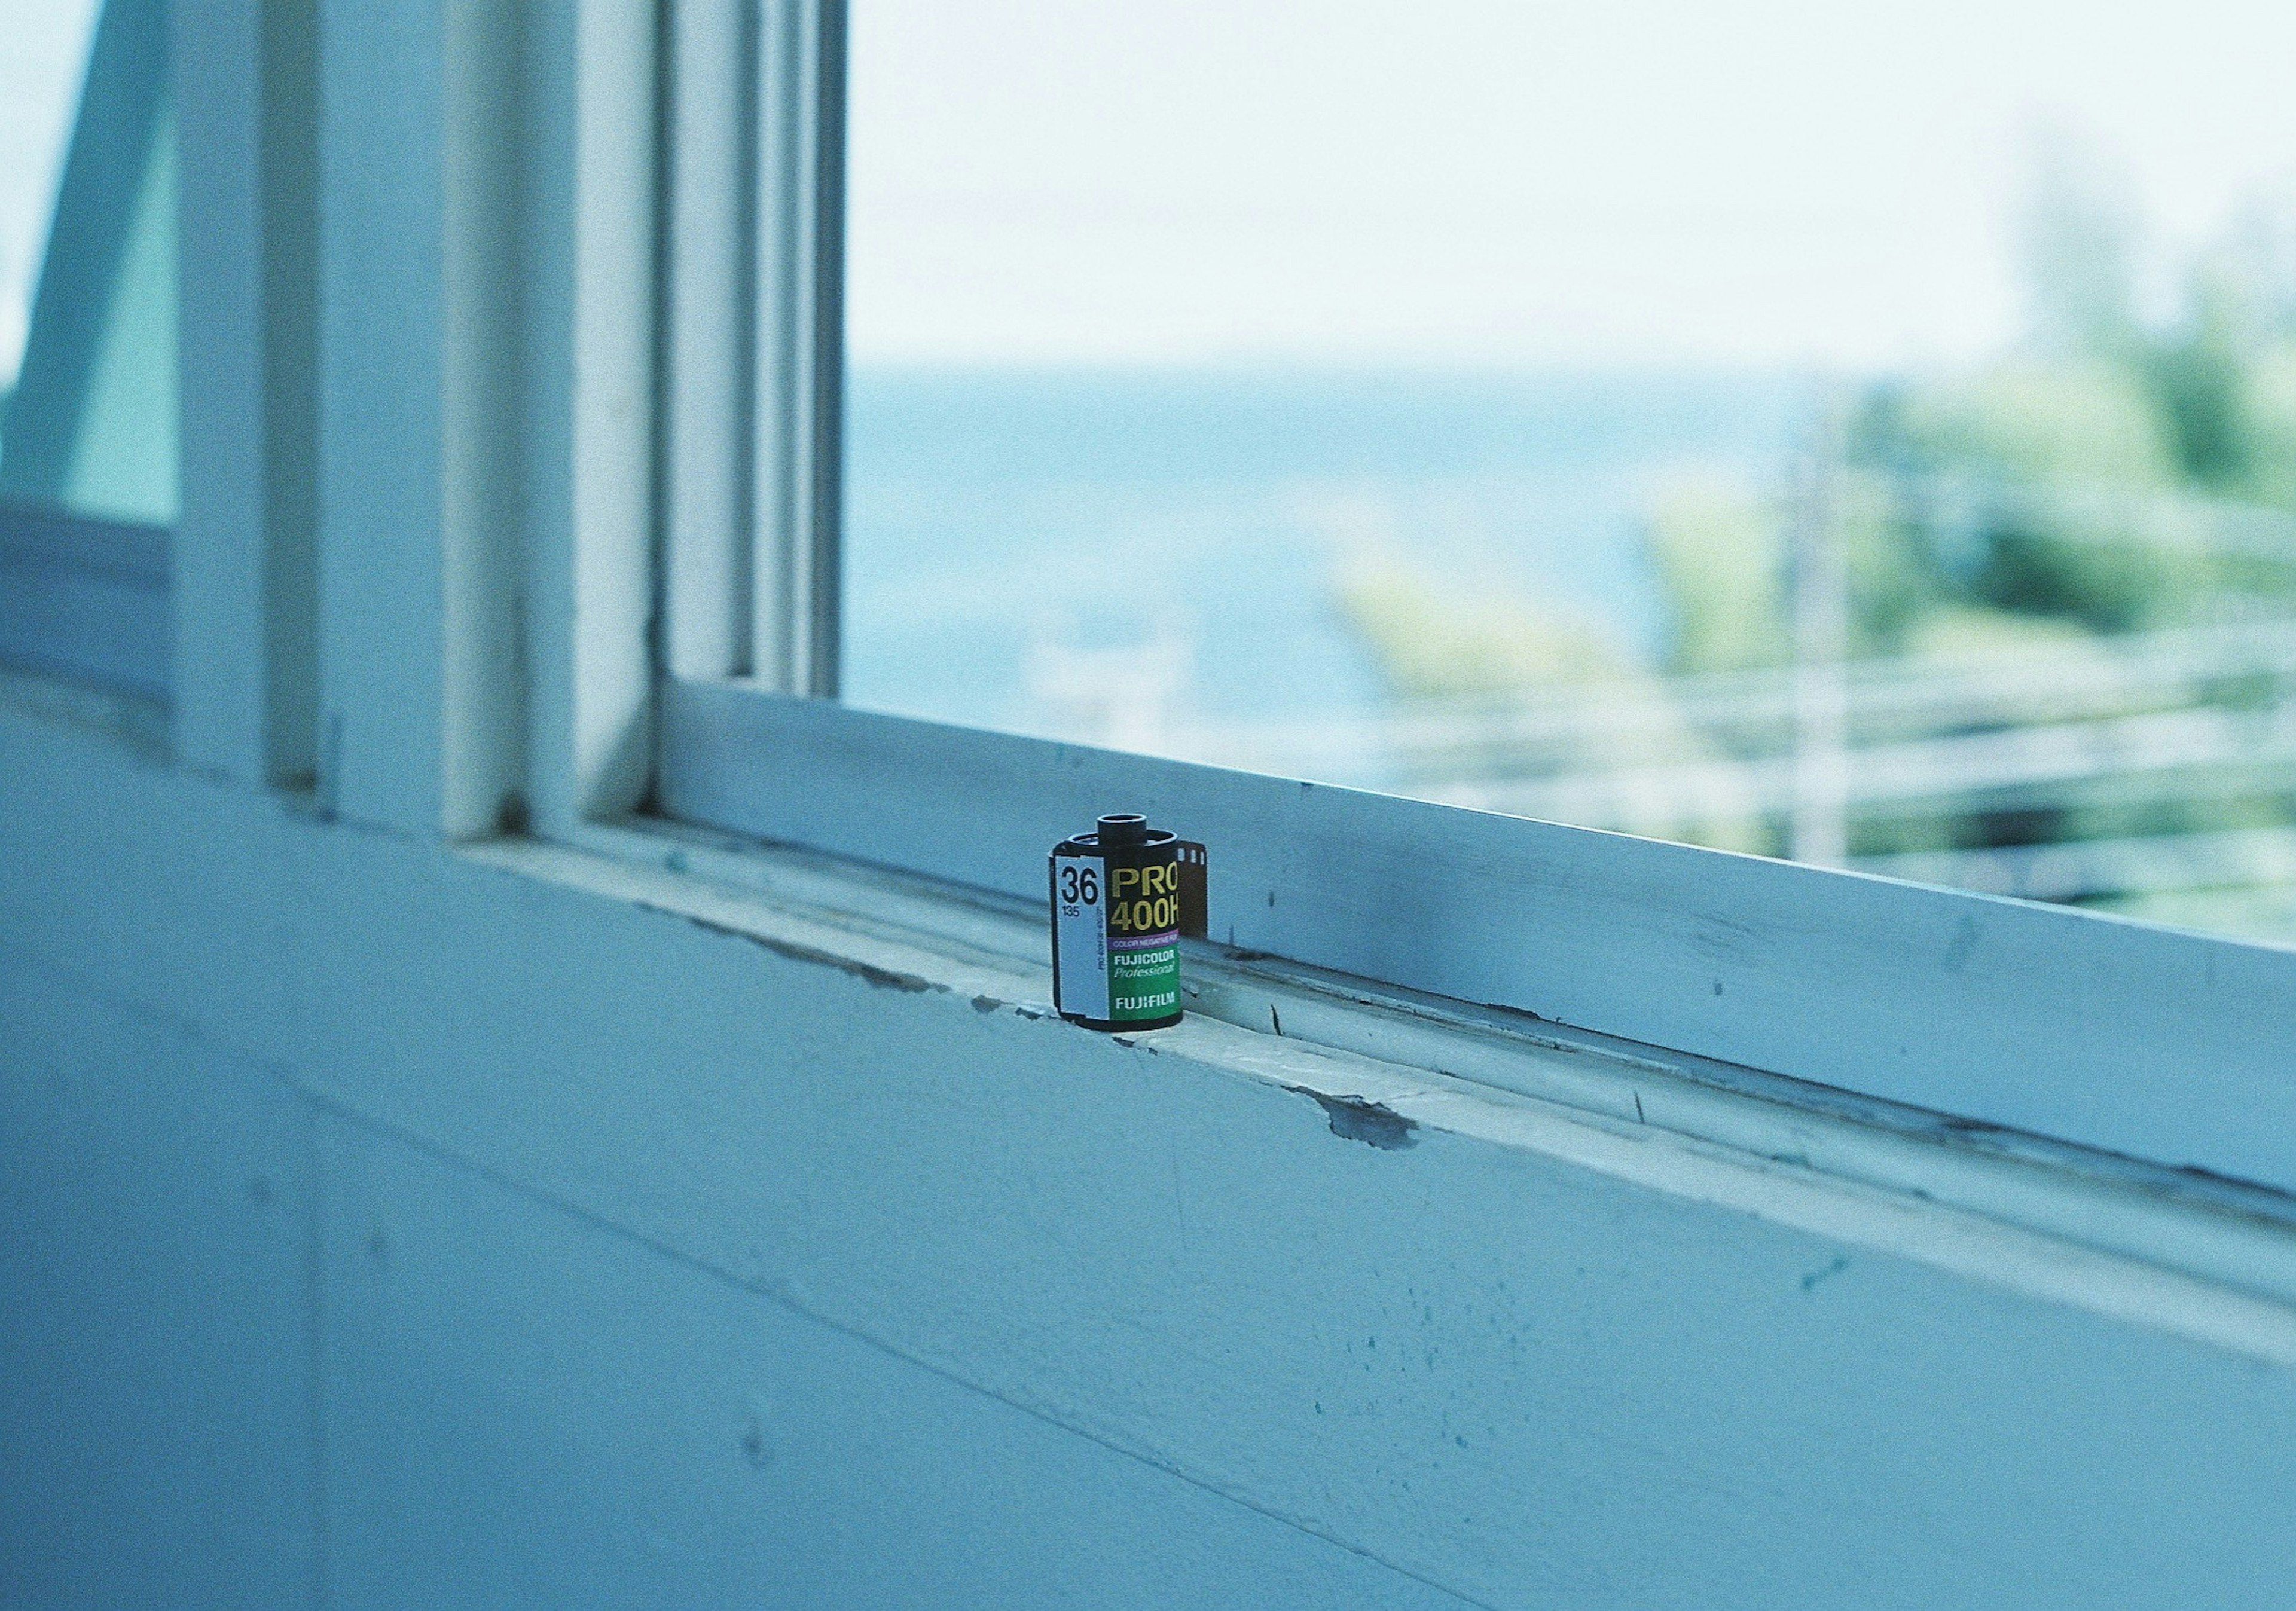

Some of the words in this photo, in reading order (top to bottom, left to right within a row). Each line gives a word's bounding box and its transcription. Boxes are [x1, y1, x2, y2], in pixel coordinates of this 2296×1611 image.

[1061, 866, 1098, 905] 36
[1112, 861, 1178, 898] PRO
[1061, 906, 1080, 917] 135
[1110, 892, 1179, 931] 400H
[1114, 949, 1175, 965] FUJICOLOR
[1113, 960, 1175, 979] Professional
[1116, 991, 1175, 1010] FUJIFILM
